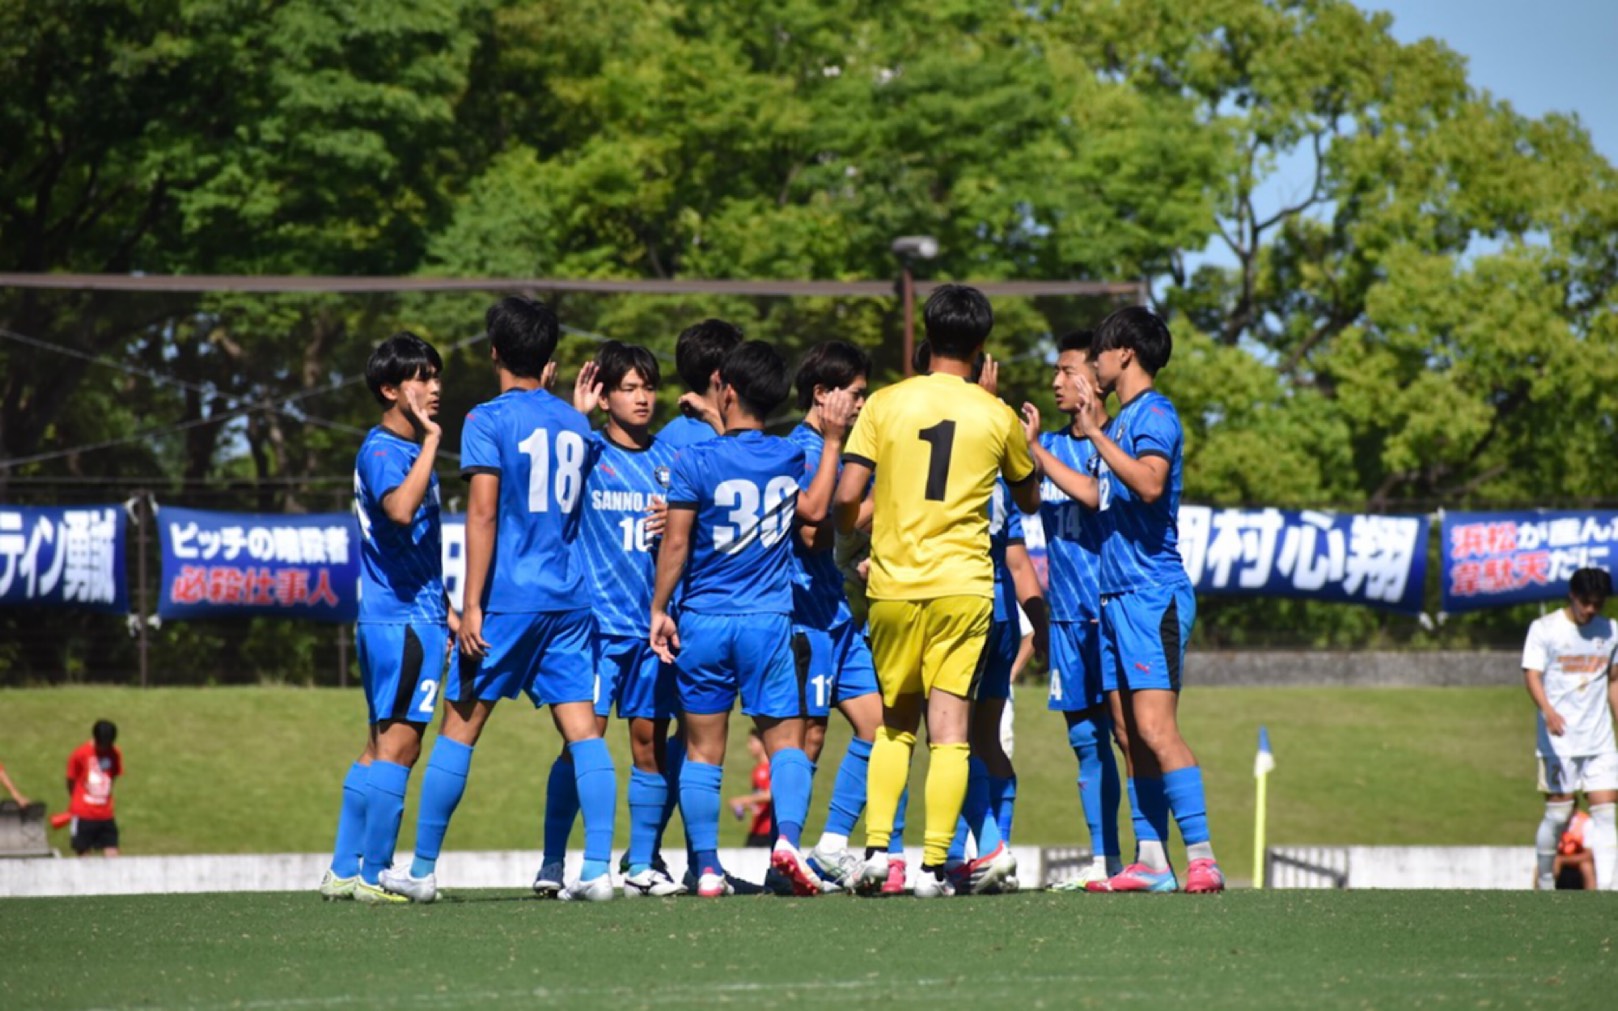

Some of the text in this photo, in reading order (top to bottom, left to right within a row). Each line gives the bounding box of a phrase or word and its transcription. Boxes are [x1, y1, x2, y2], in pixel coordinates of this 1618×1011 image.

[517, 427, 585, 515] 18
[918, 419, 956, 502] 1
[591, 488, 644, 512] SANNO
[712, 475, 798, 556] 30
[1055, 504, 1082, 540] 14
[1451, 516, 1618, 559] 浜松が産ん
[172, 565, 339, 607] 必殺仕事人
[419, 679, 440, 712] 2
